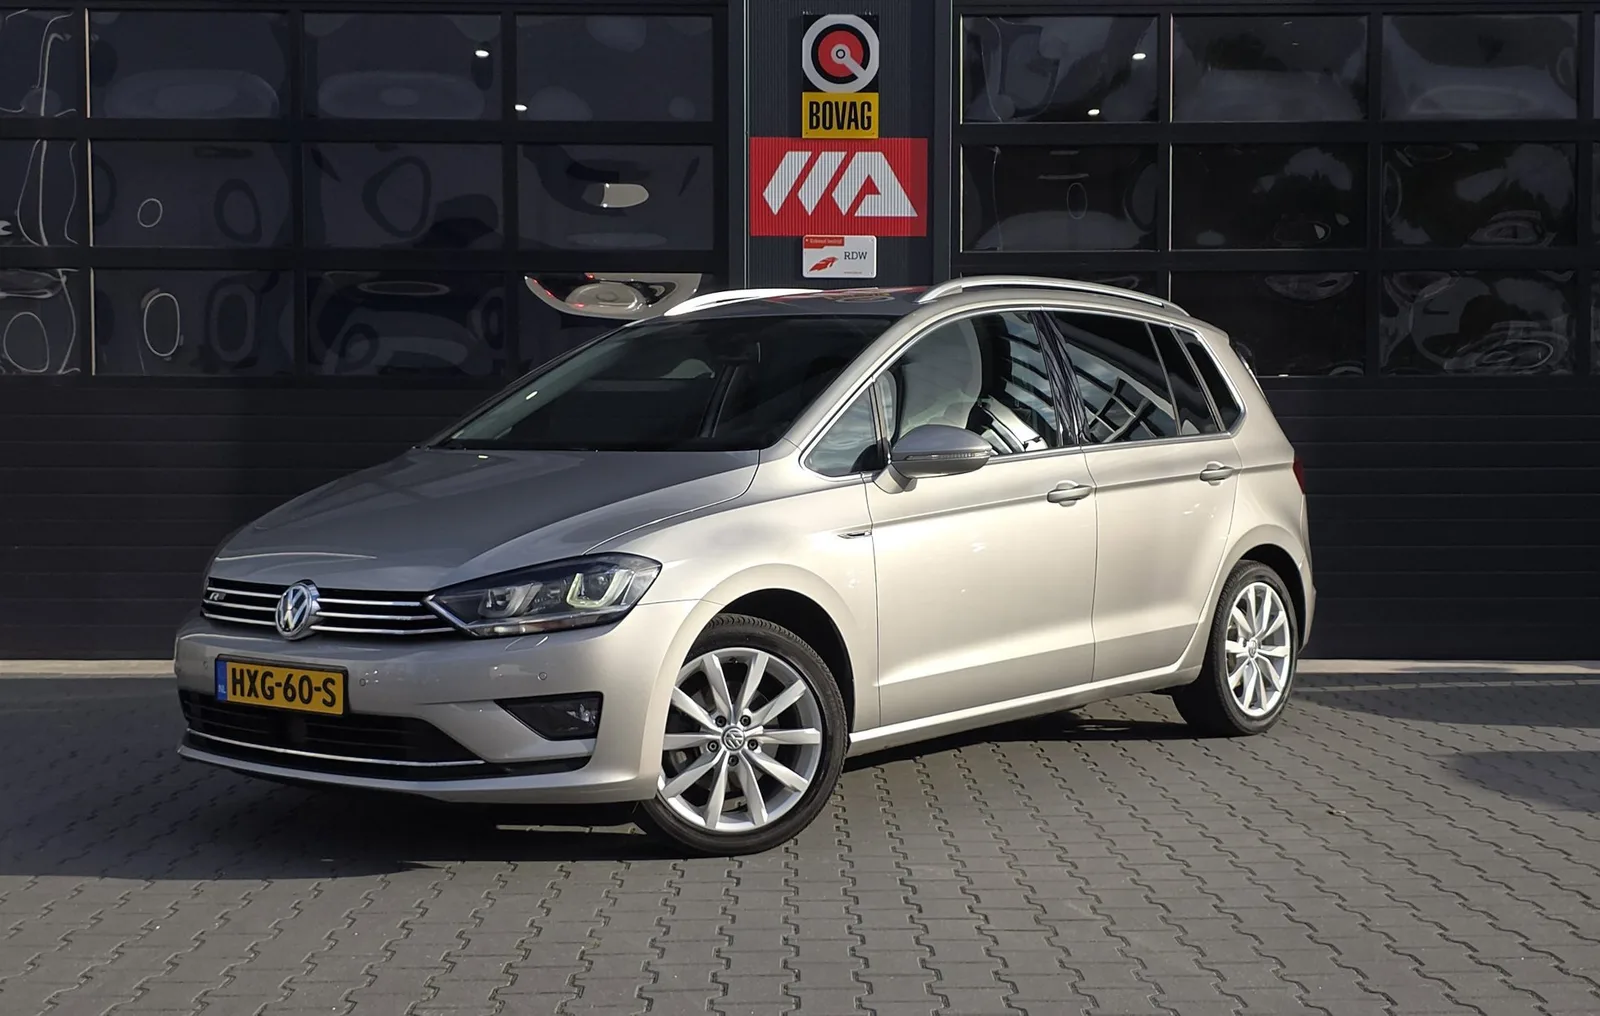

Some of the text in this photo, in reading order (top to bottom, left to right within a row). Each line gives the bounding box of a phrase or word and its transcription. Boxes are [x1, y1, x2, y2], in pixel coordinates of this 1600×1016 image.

[809, 101, 872, 130] BOVAG
[844, 251, 868, 260] RDW
[231, 667, 336, 708] HXG-60-S
